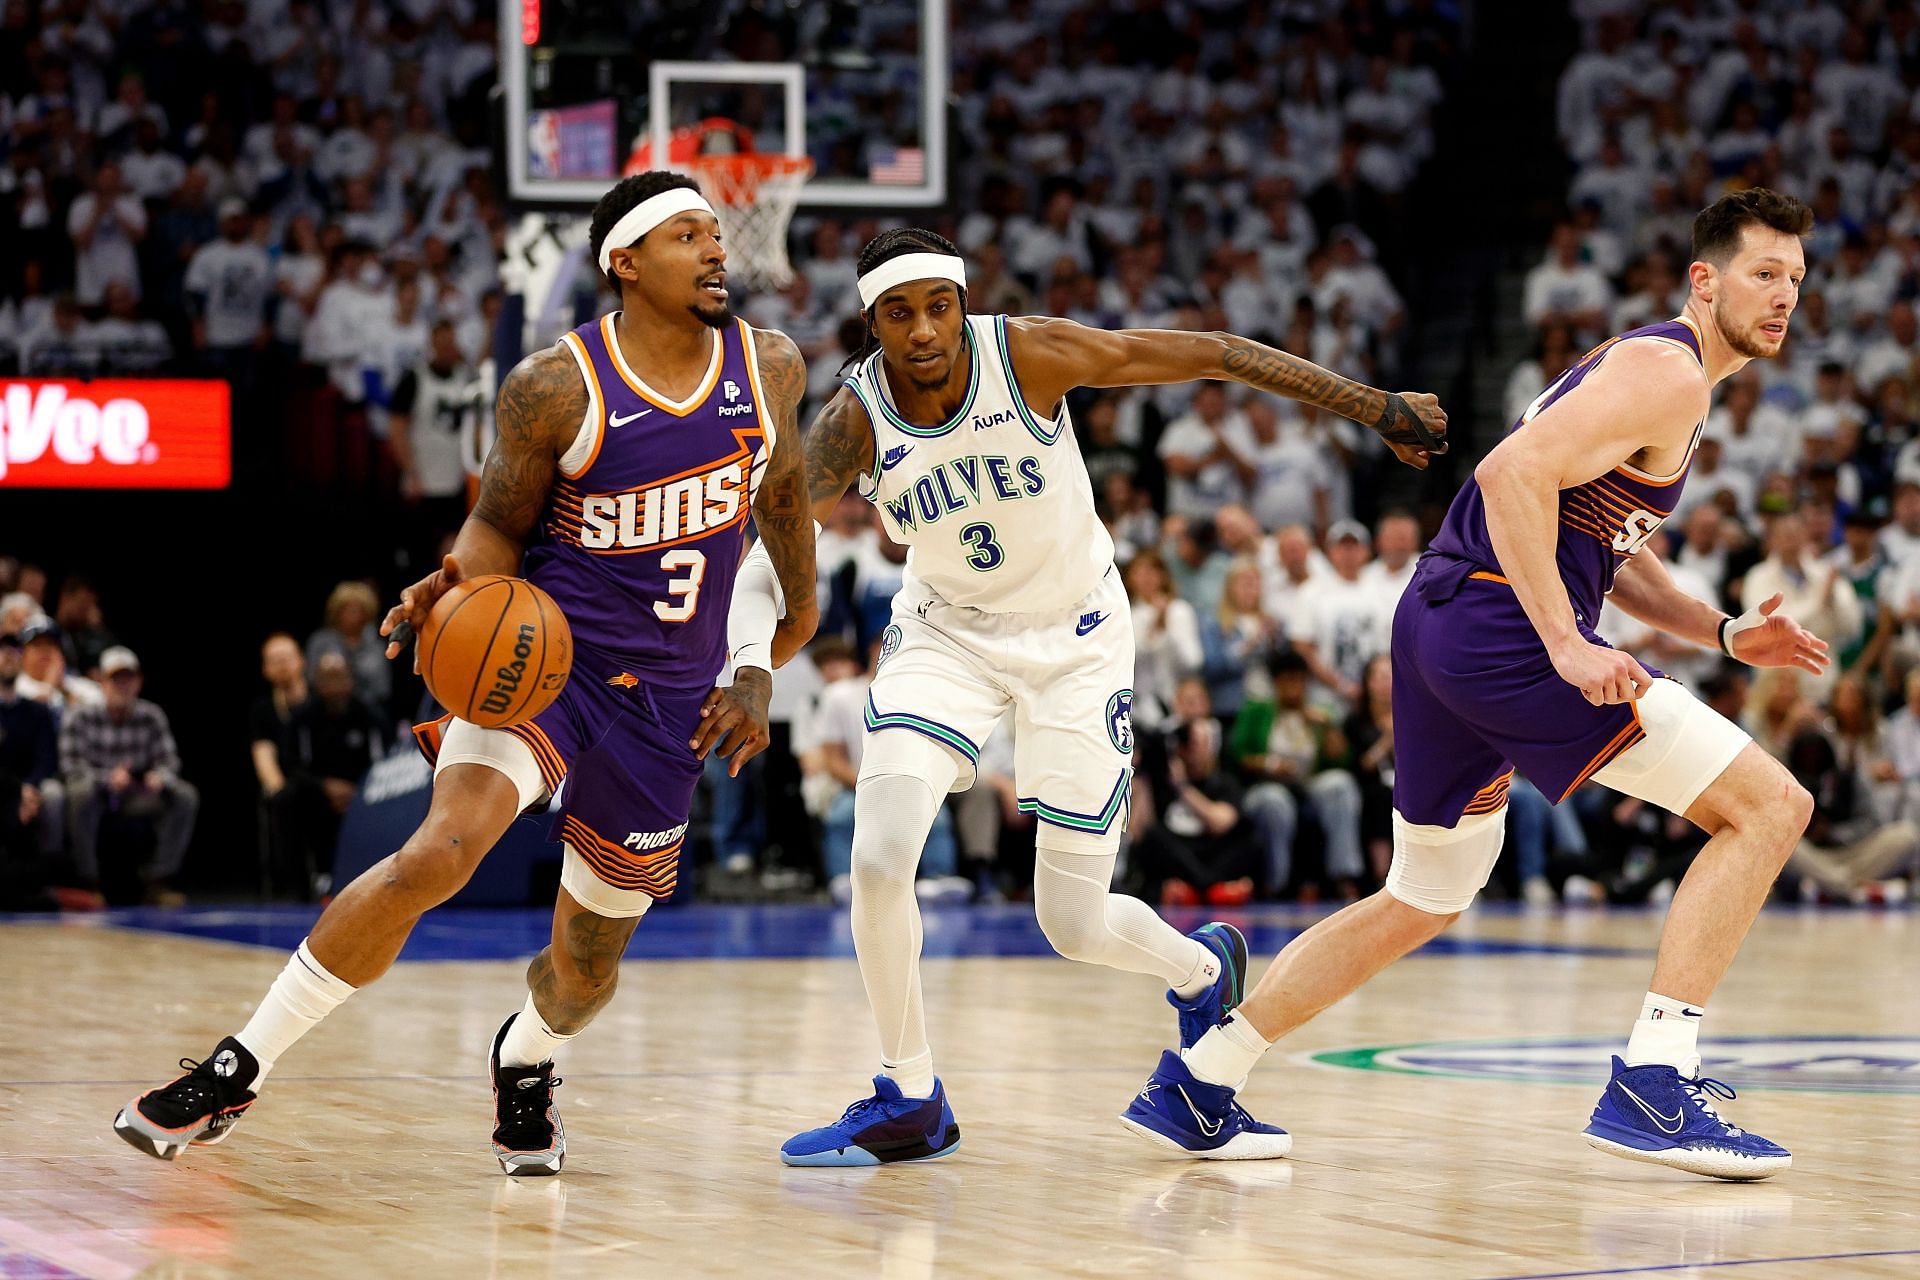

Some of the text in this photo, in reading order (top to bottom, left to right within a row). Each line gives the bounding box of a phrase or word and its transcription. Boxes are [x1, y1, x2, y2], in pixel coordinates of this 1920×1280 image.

[718, 402, 753, 417] PayPal
[885, 443, 906, 462] NIKE
[580, 463, 743, 550] SUNS
[883, 455, 1046, 536] WOLVES
[959, 521, 1005, 572] 3
[652, 549, 708, 623] 3
[1079, 610, 1101, 628] NIKE
[479, 623, 536, 715] Wilson
